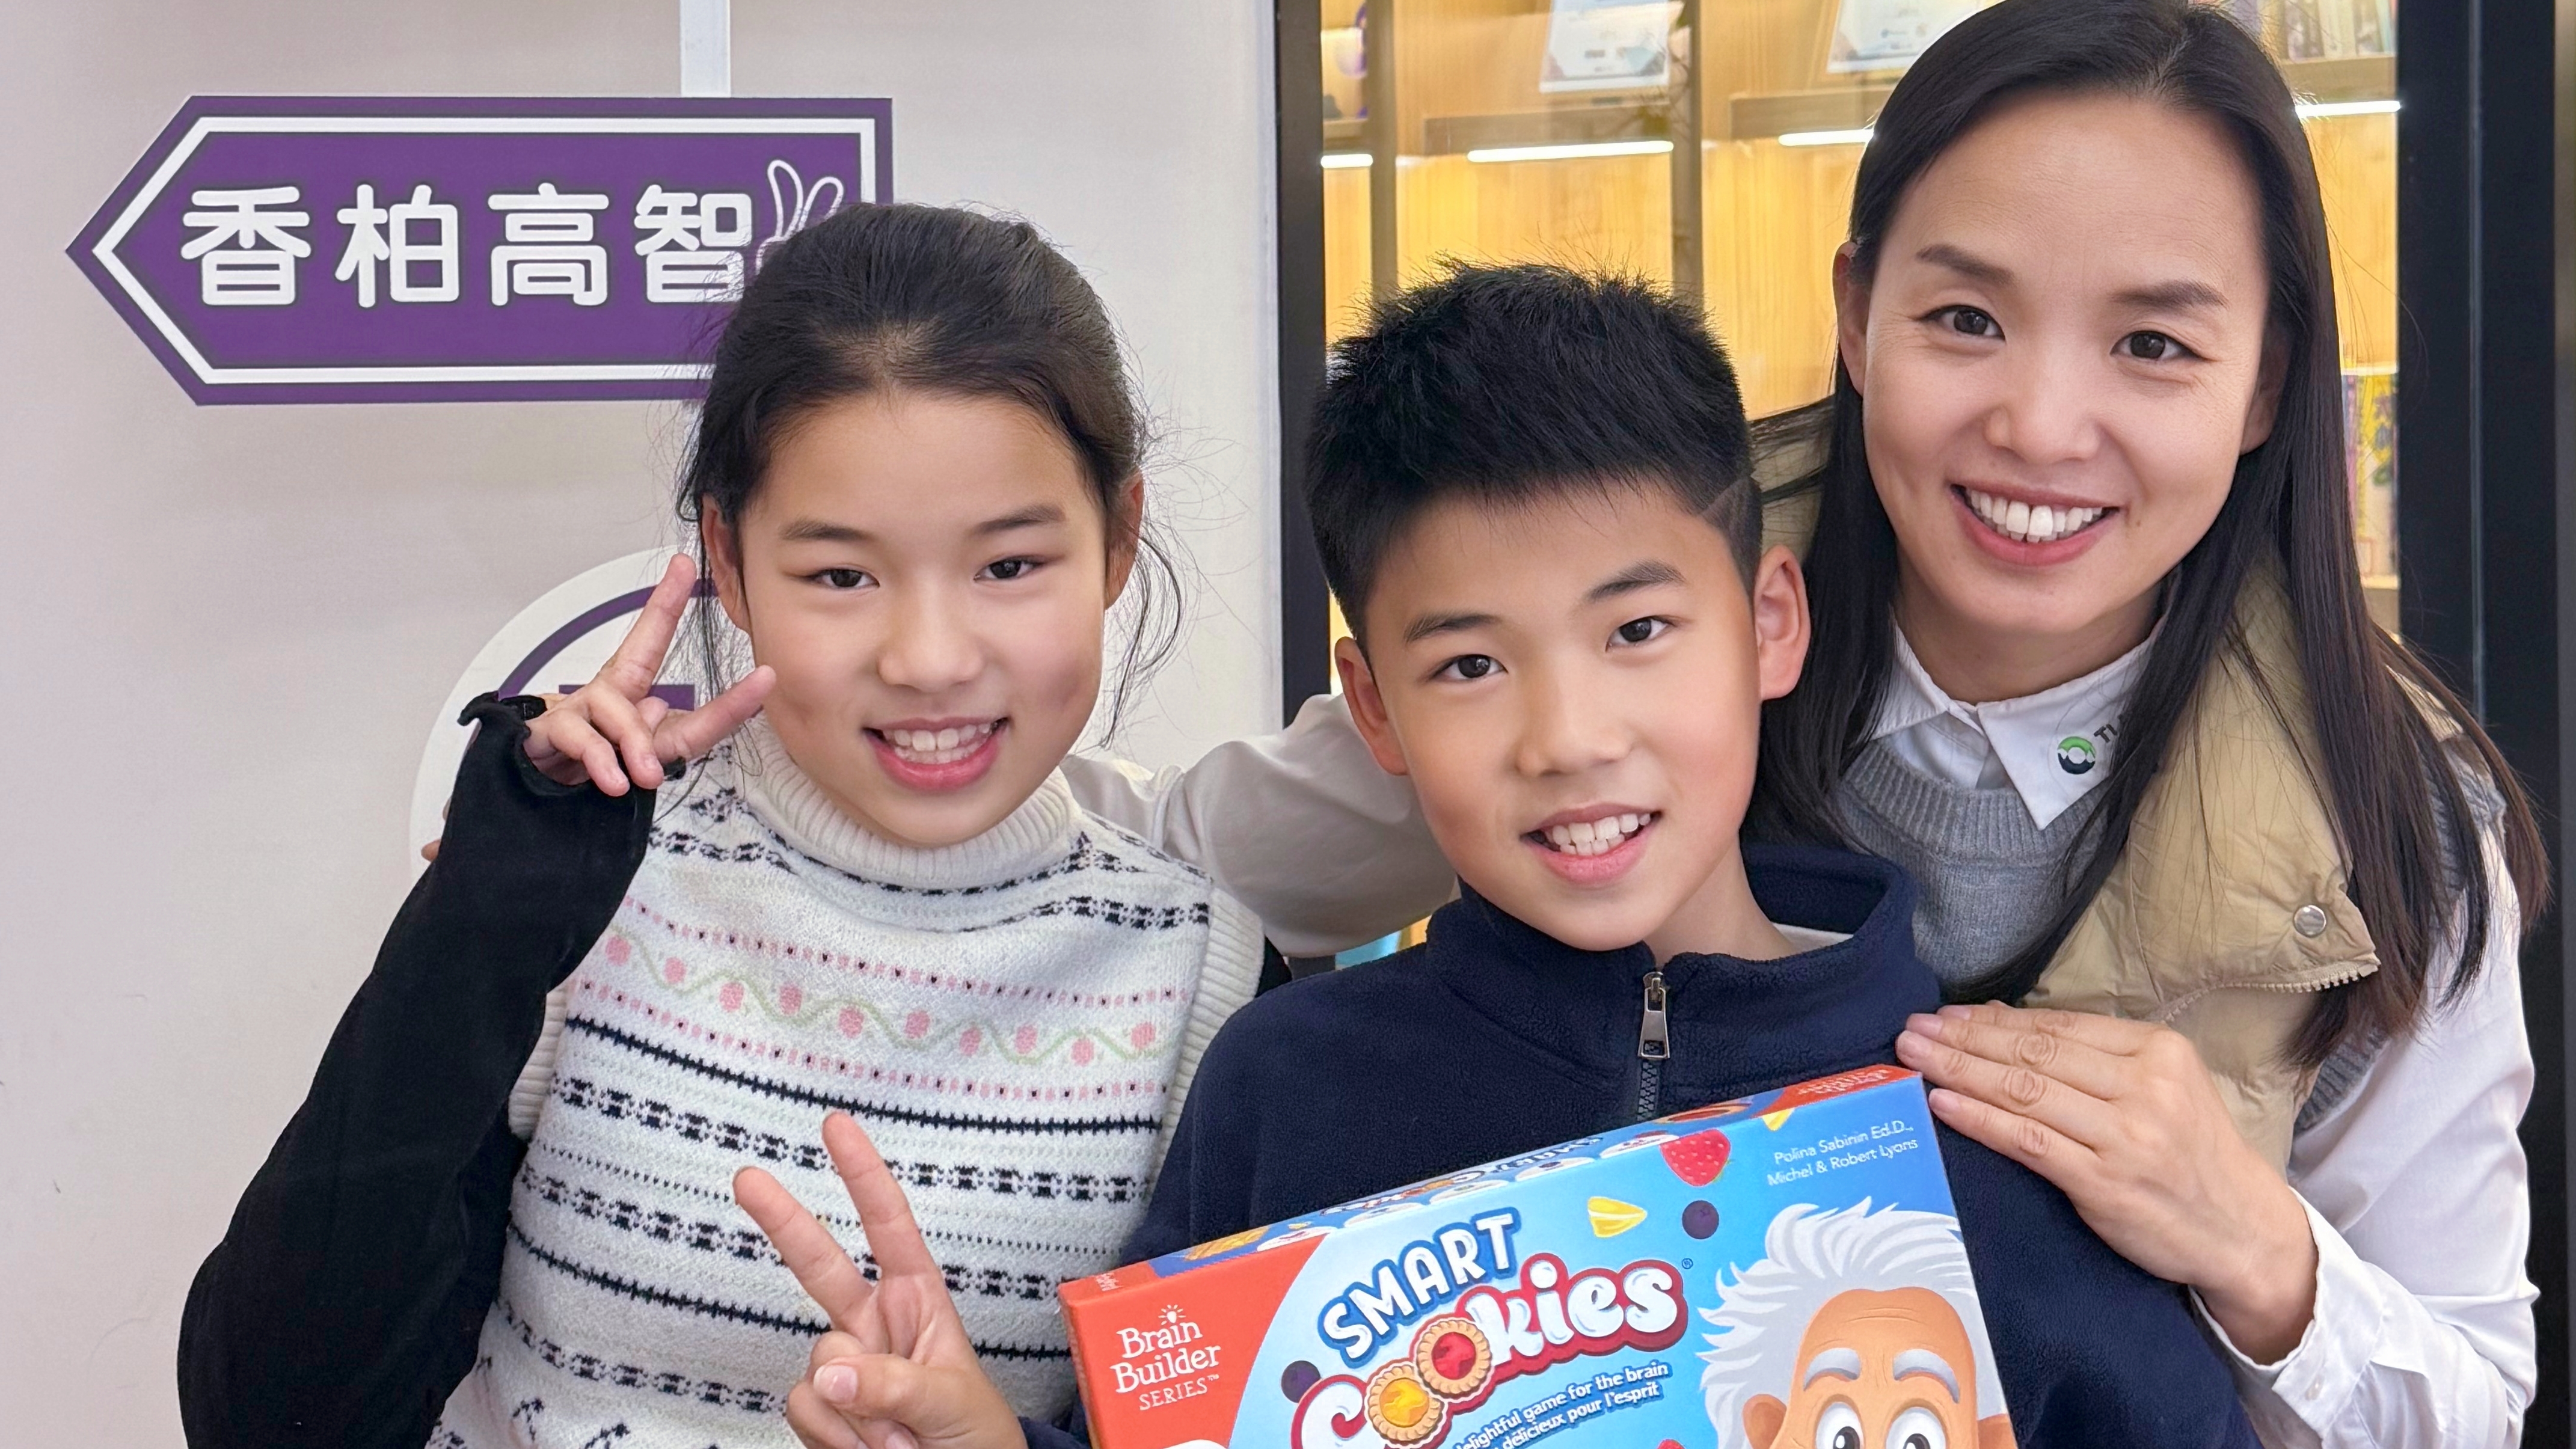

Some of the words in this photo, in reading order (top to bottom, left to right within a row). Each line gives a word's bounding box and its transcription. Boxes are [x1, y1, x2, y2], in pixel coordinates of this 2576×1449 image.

[181, 183, 752, 307] 香柏高智
[1767, 1163, 1813, 1186] Michel
[1816, 1161, 1828, 1173] &
[1830, 1150, 1877, 1169] Robert
[1879, 1139, 1918, 1159] Lyons
[1774, 1146, 1817, 1164] Polina
[1819, 1132, 1868, 1153] Sabinin
[1323, 1213, 1513, 1359] SMART
[1116, 1322, 1203, 1358] Brain
[1301, 1260, 1679, 1449] Cookies
[1109, 1346, 1221, 1393] Builder
[1524, 1393, 1568, 1422] game
[1568, 1384, 1592, 1400] for
[1595, 1374, 1623, 1390] the
[1625, 1362, 1669, 1382] brain
[1569, 1400, 1602, 1423] pour
[1605, 1382, 1660, 1408] l'esprit
